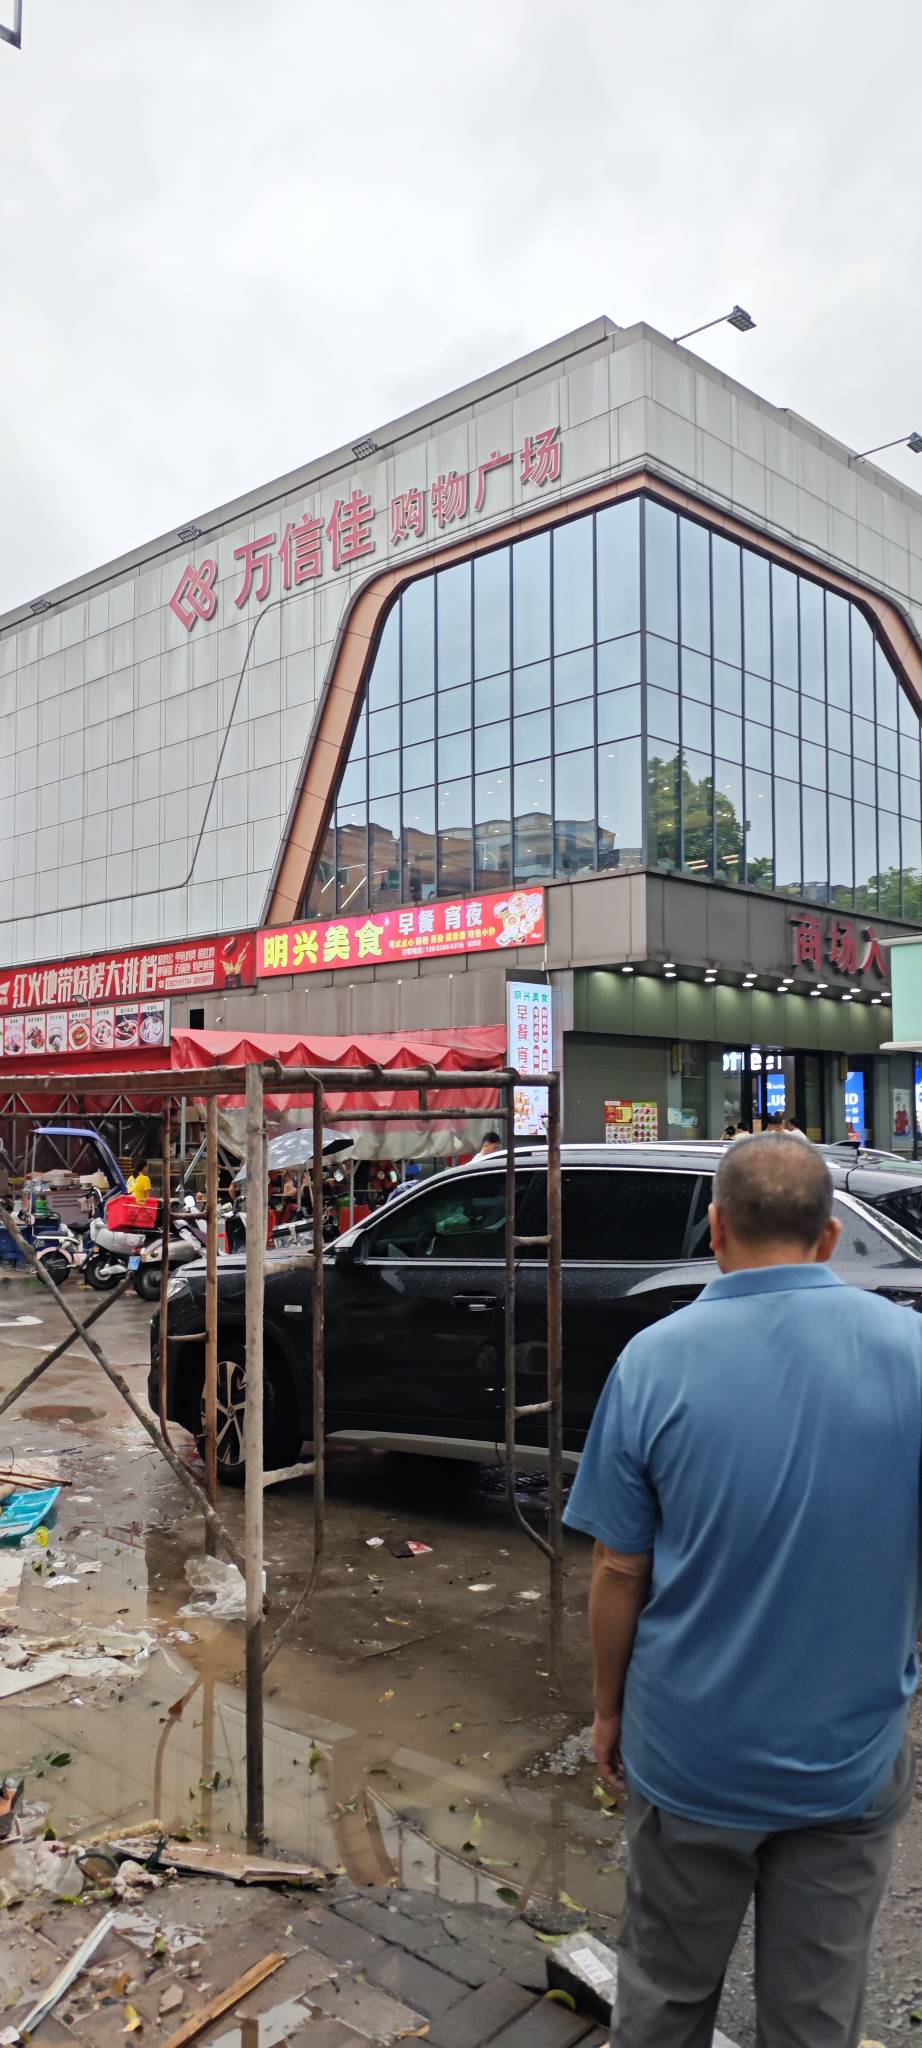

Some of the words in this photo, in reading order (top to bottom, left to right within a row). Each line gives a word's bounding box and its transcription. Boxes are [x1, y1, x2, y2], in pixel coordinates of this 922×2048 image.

[234, 488, 376, 608] 万信佳
[390, 425, 562, 545] 购物广场
[263, 920, 384, 969] 明兴美食
[398, 911, 435, 936] 早餐
[445, 902, 483, 930] 宵夜
[789, 912, 889, 977] 商场入
[12, 954, 158, 1009] 红火地带烧烤大排档
[514, 990, 548, 1004] 明兴美食
